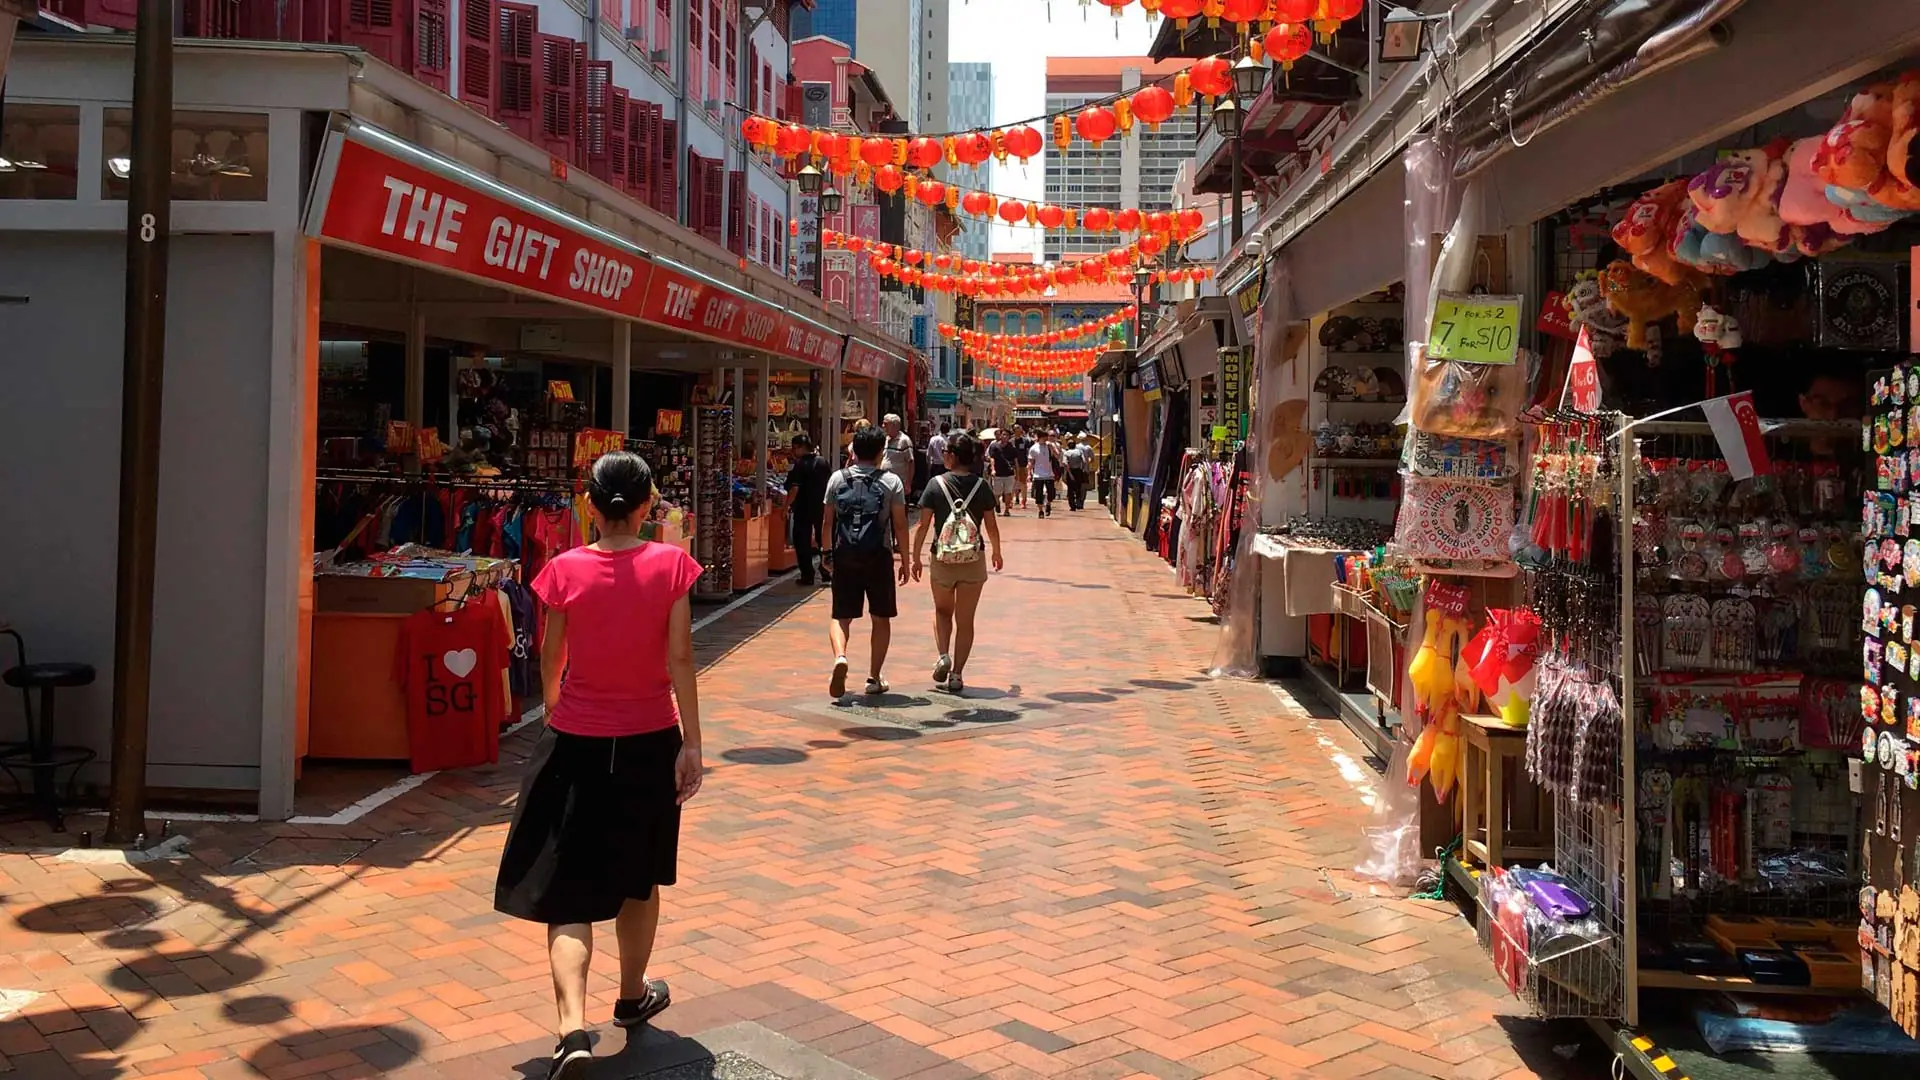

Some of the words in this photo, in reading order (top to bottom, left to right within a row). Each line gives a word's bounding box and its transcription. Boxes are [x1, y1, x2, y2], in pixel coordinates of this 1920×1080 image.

[141, 213, 155, 241] 8
[381, 175, 468, 253] THE
[484, 216, 560, 280] GIFT
[569, 248, 634, 301] SHOP
[664, 281, 702, 321] THE
[703, 296, 740, 332] GIFT
[741, 311, 775, 342] SHOP
[786, 325, 804, 352] THE
[1439, 321, 1455, 346] 7
[1225, 354, 1238, 399] MONEY
[1427, 594, 1435, 603] 3
[422, 653, 438, 683] I
[425, 682, 477, 717] SG
